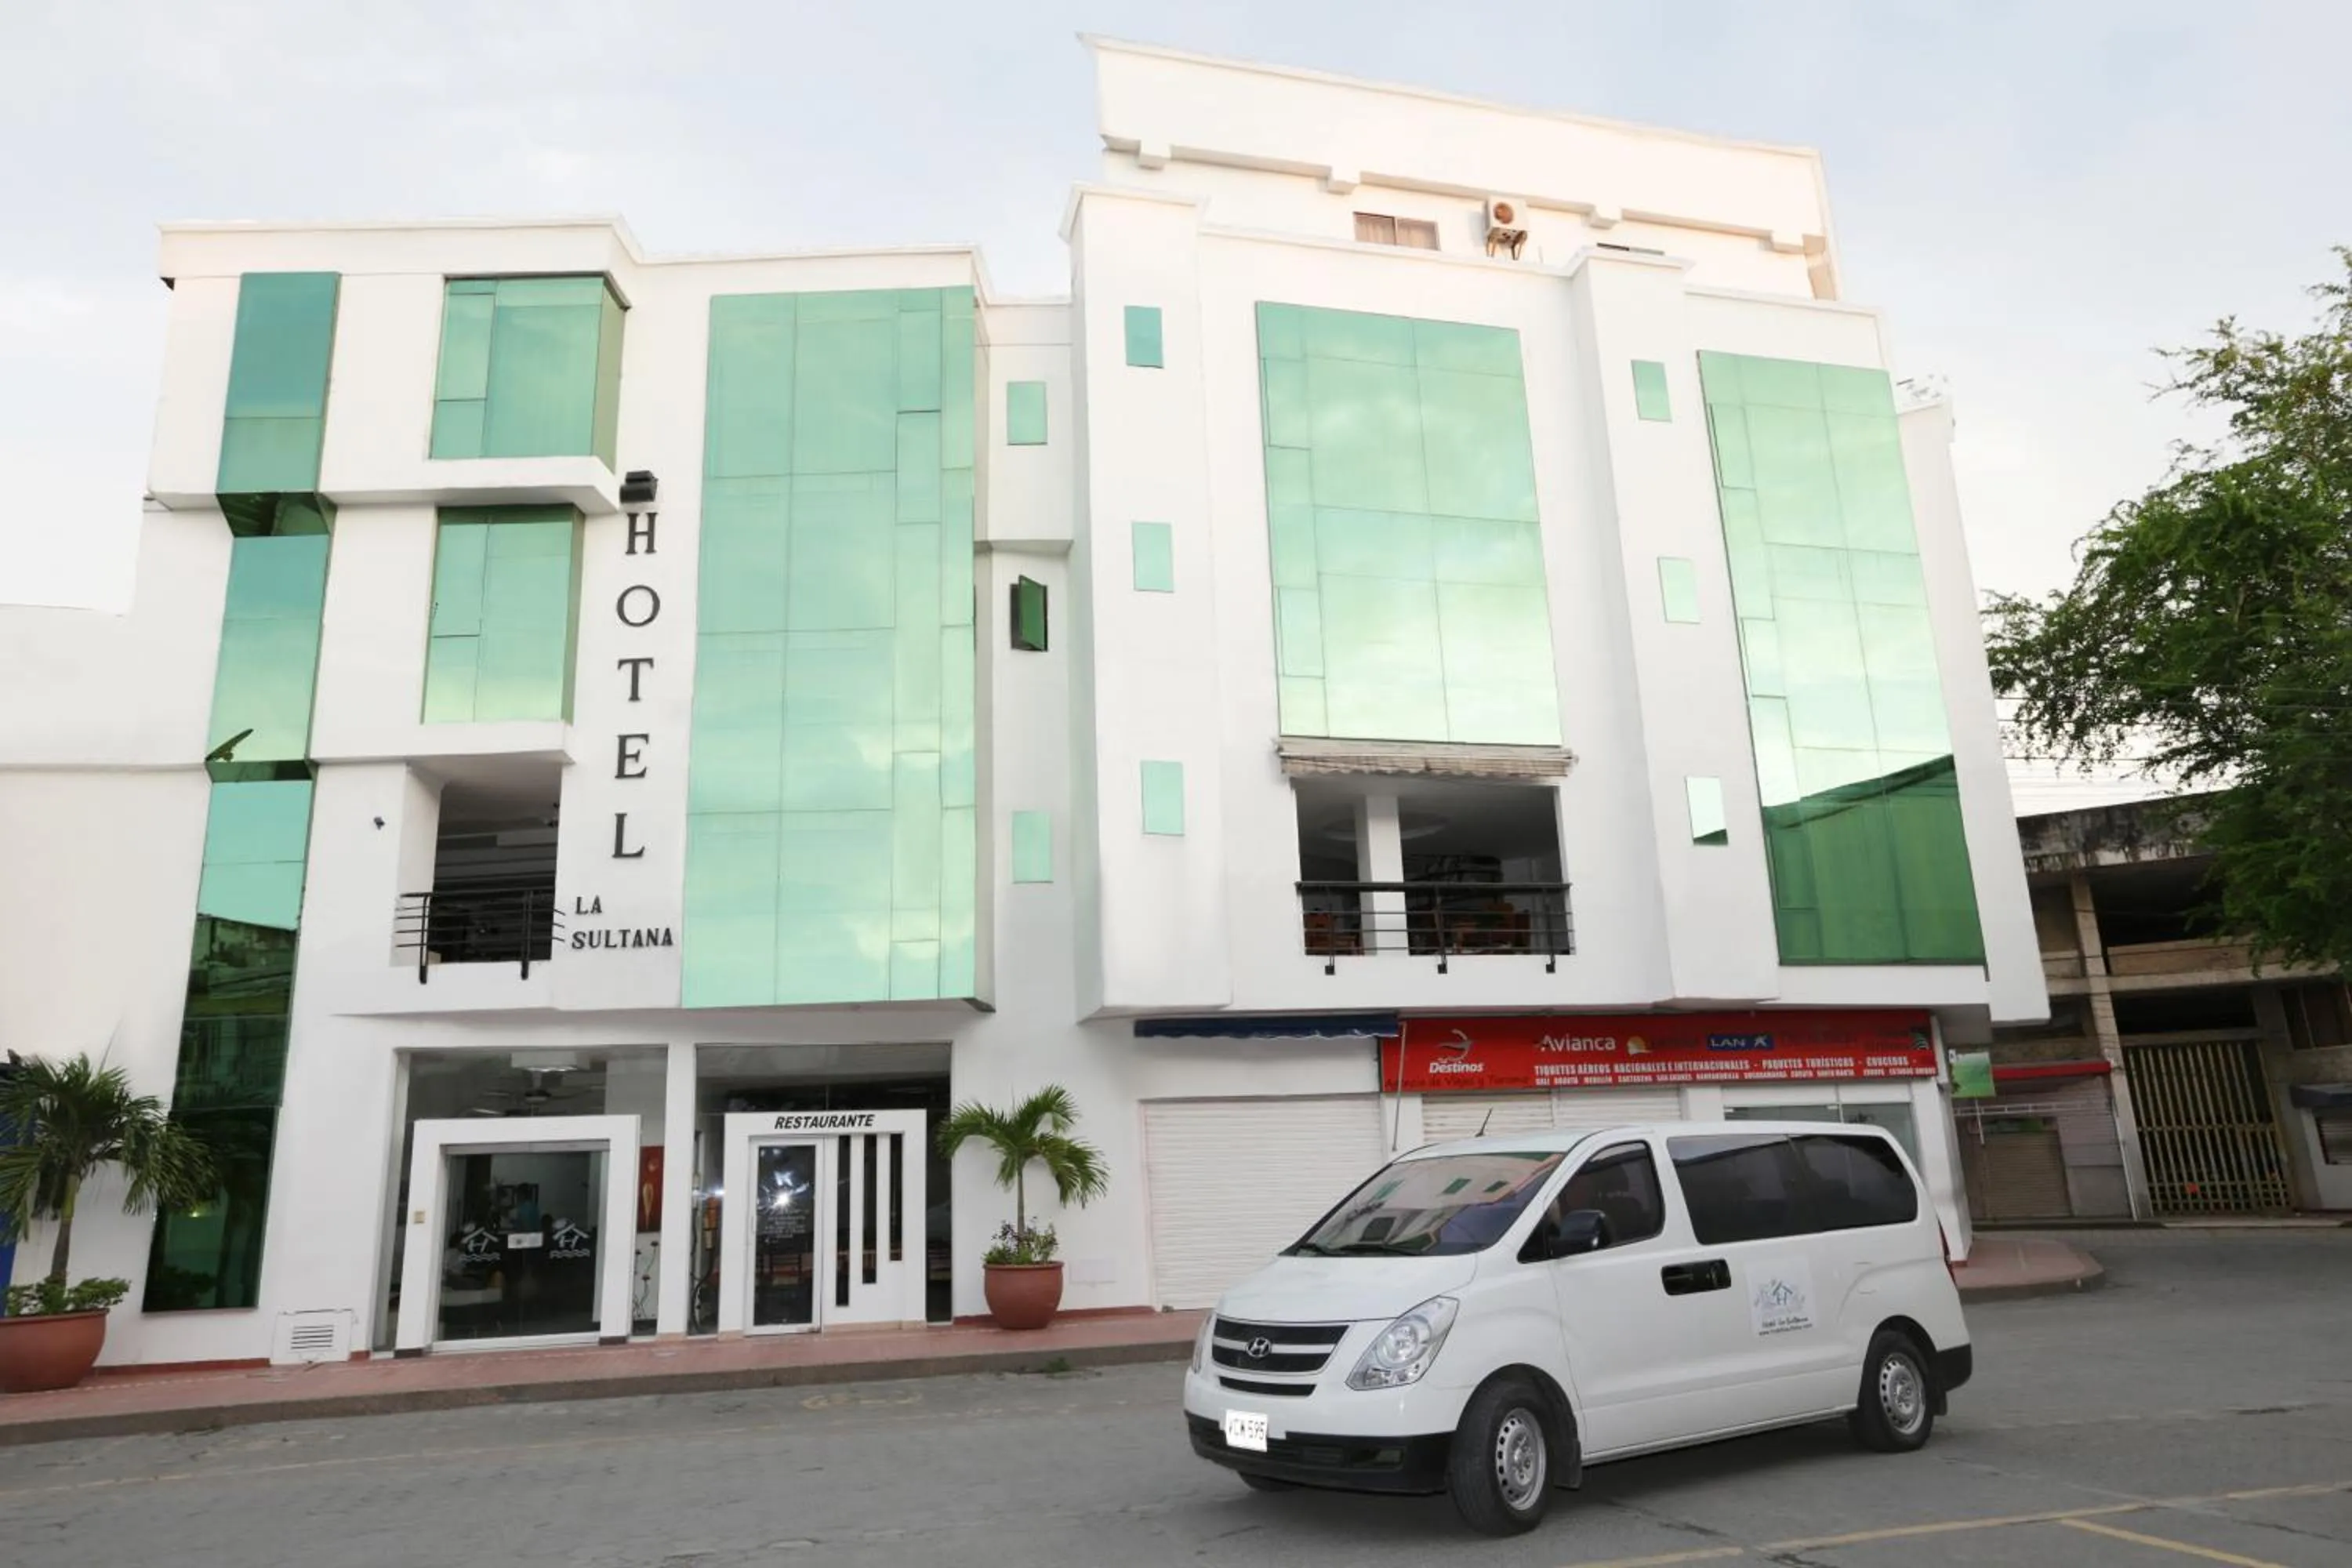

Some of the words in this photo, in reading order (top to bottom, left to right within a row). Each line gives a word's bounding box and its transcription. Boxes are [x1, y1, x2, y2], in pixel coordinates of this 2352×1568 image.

[612, 511, 660, 860] HOTEL
[576, 895, 602, 916] LA
[572, 927, 673, 950] SULTANA
[1541, 1034, 1616, 1051] Avianca
[1711, 1037, 1746, 1047] LAN
[1429, 1061, 1484, 1073] Destinos
[775, 1114, 875, 1130] RESTAURANTE
